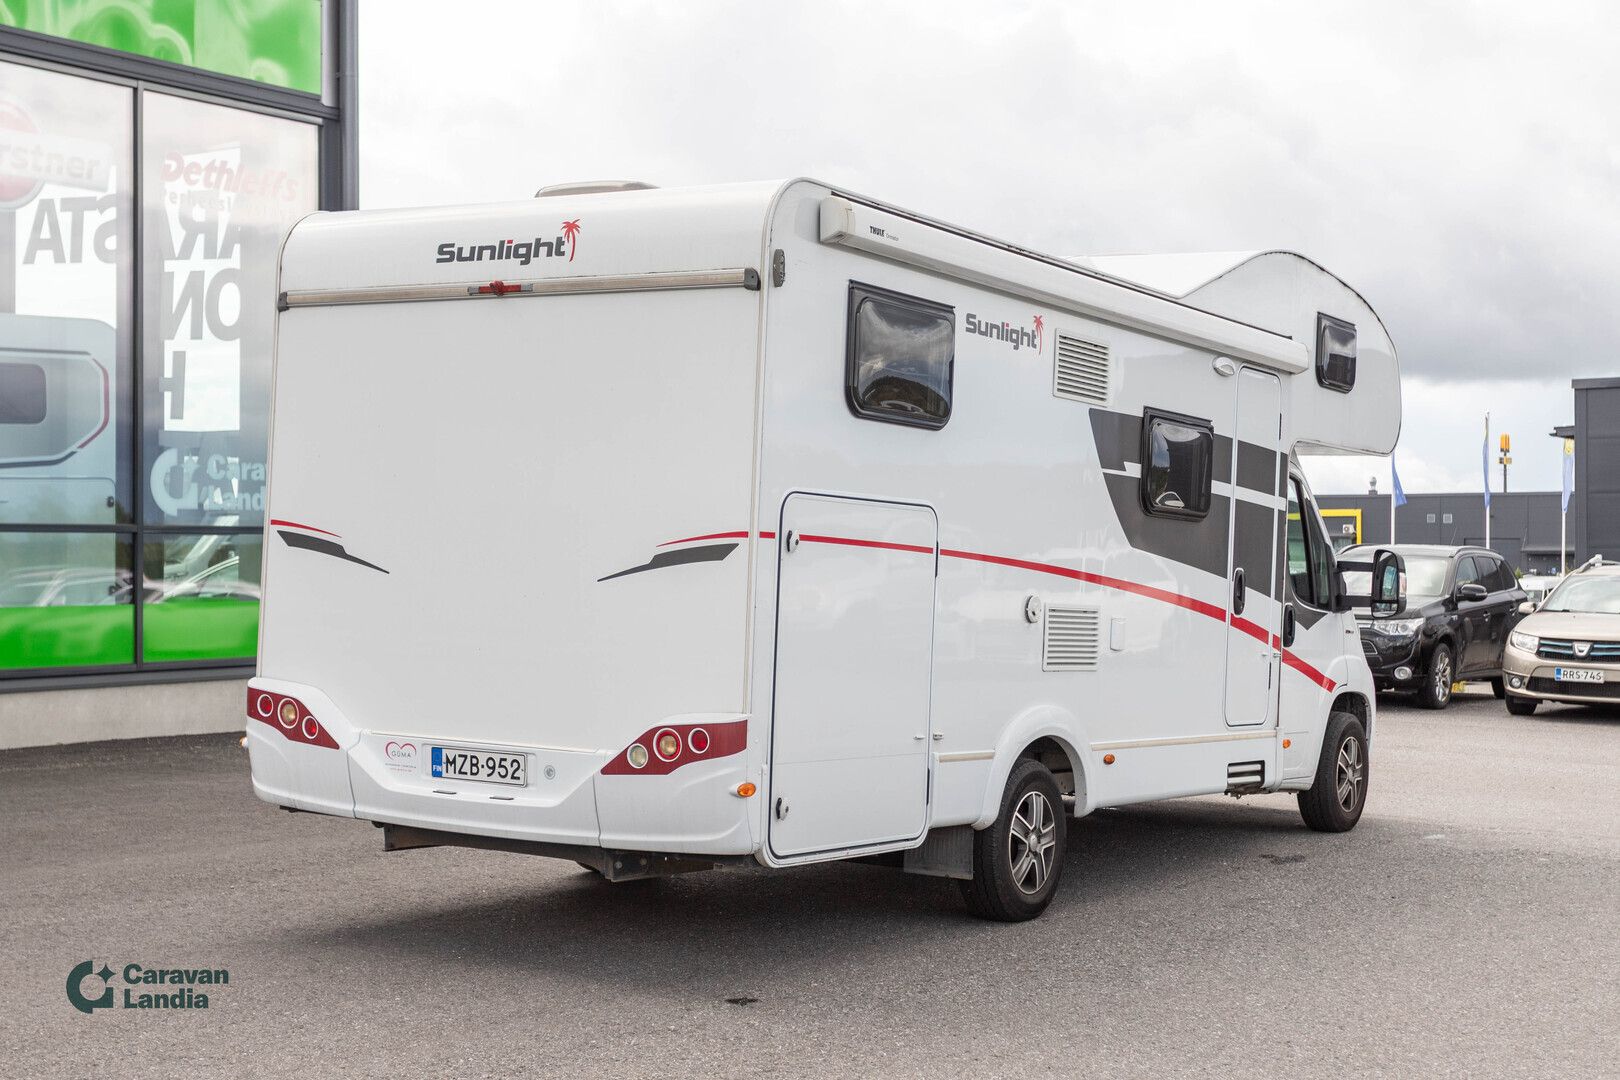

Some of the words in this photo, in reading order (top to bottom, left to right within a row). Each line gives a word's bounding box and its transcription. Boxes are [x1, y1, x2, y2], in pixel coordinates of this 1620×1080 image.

[436, 236, 566, 266] Sunlight
[965, 313, 1037, 350] Sunlight
[206, 454, 265, 481] Cara
[445, 753, 521, 781] MZB-952
